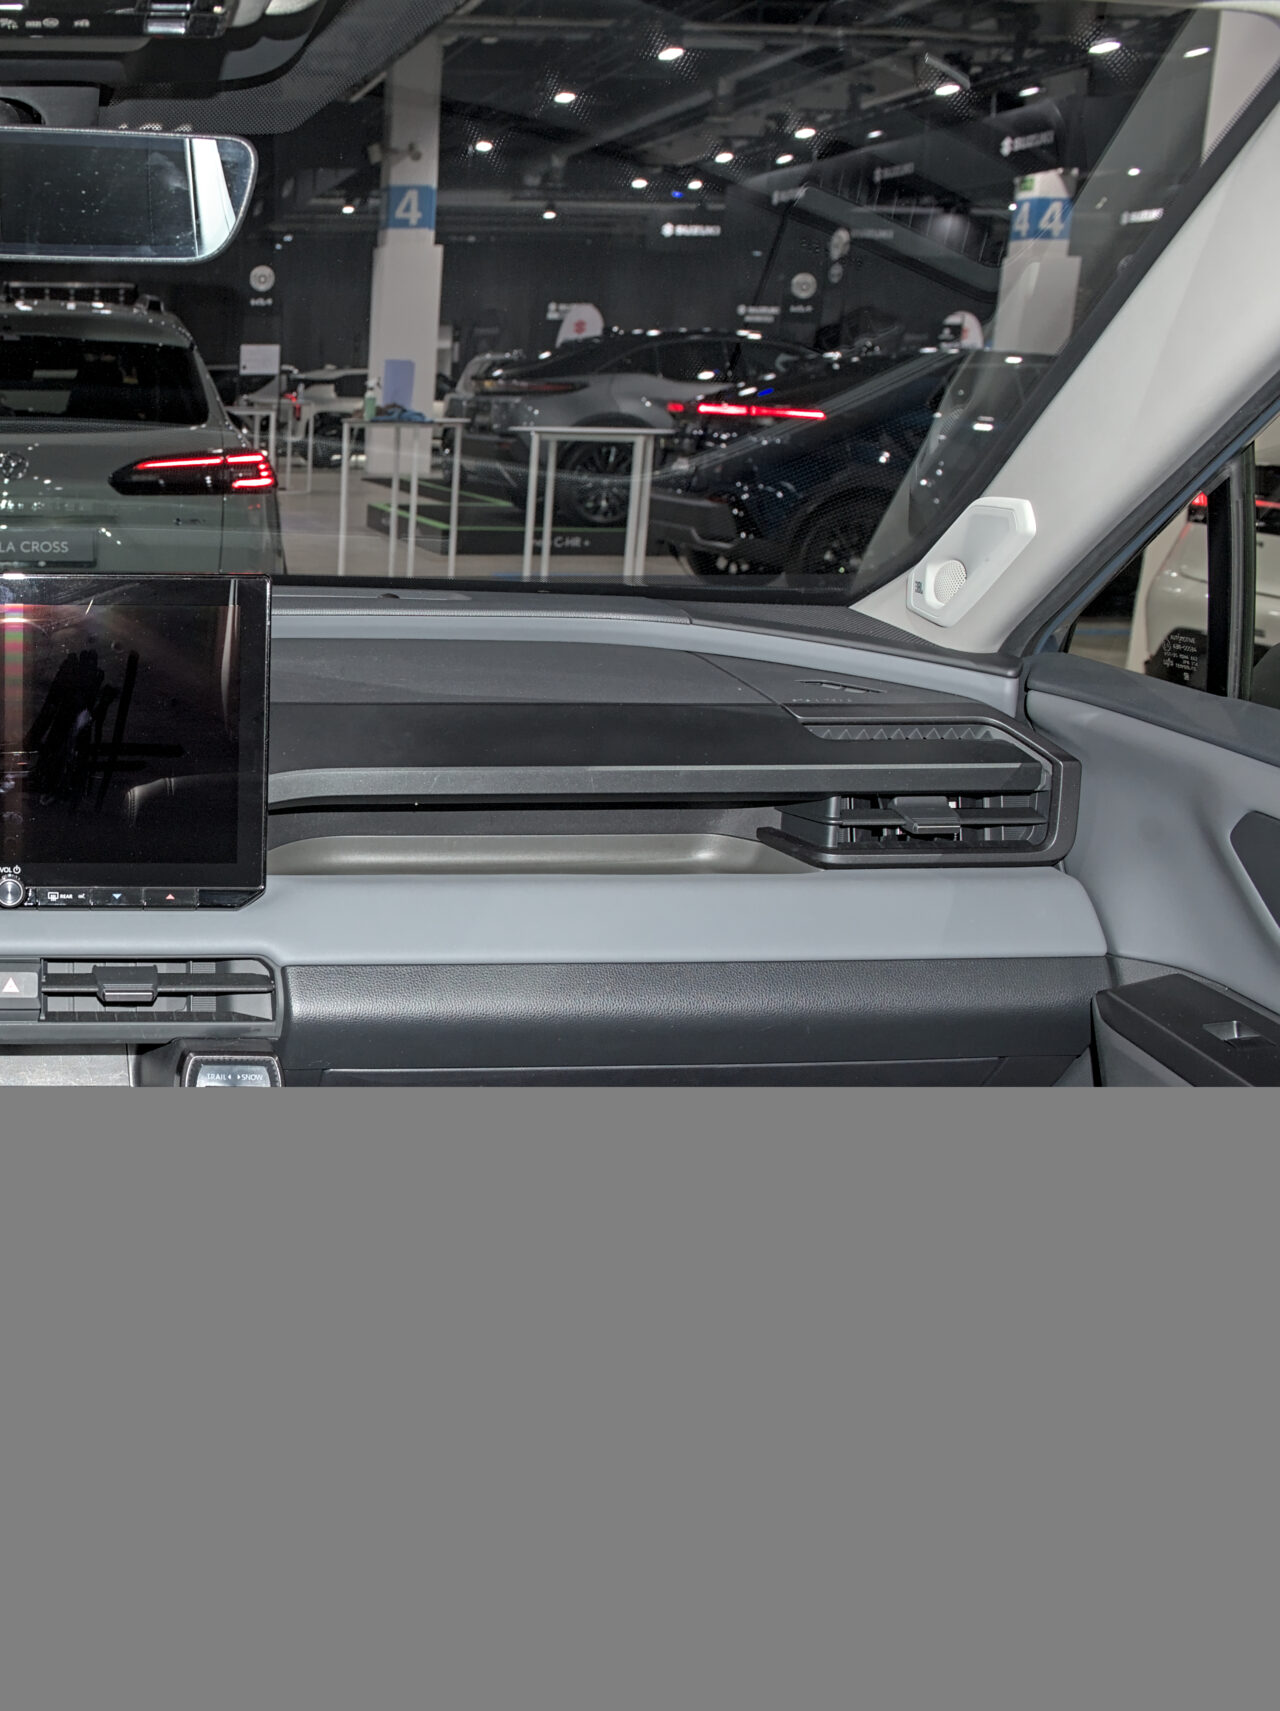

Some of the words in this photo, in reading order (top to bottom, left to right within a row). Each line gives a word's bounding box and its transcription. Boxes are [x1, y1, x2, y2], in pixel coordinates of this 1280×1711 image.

[394, 189, 422, 226] 4
[1038, 201, 1065, 238] 4
[20, 541, 69, 553] CROSS
[207, 1073, 227, 1081] TRAIL
[241, 1073, 263, 1081] SNOW
